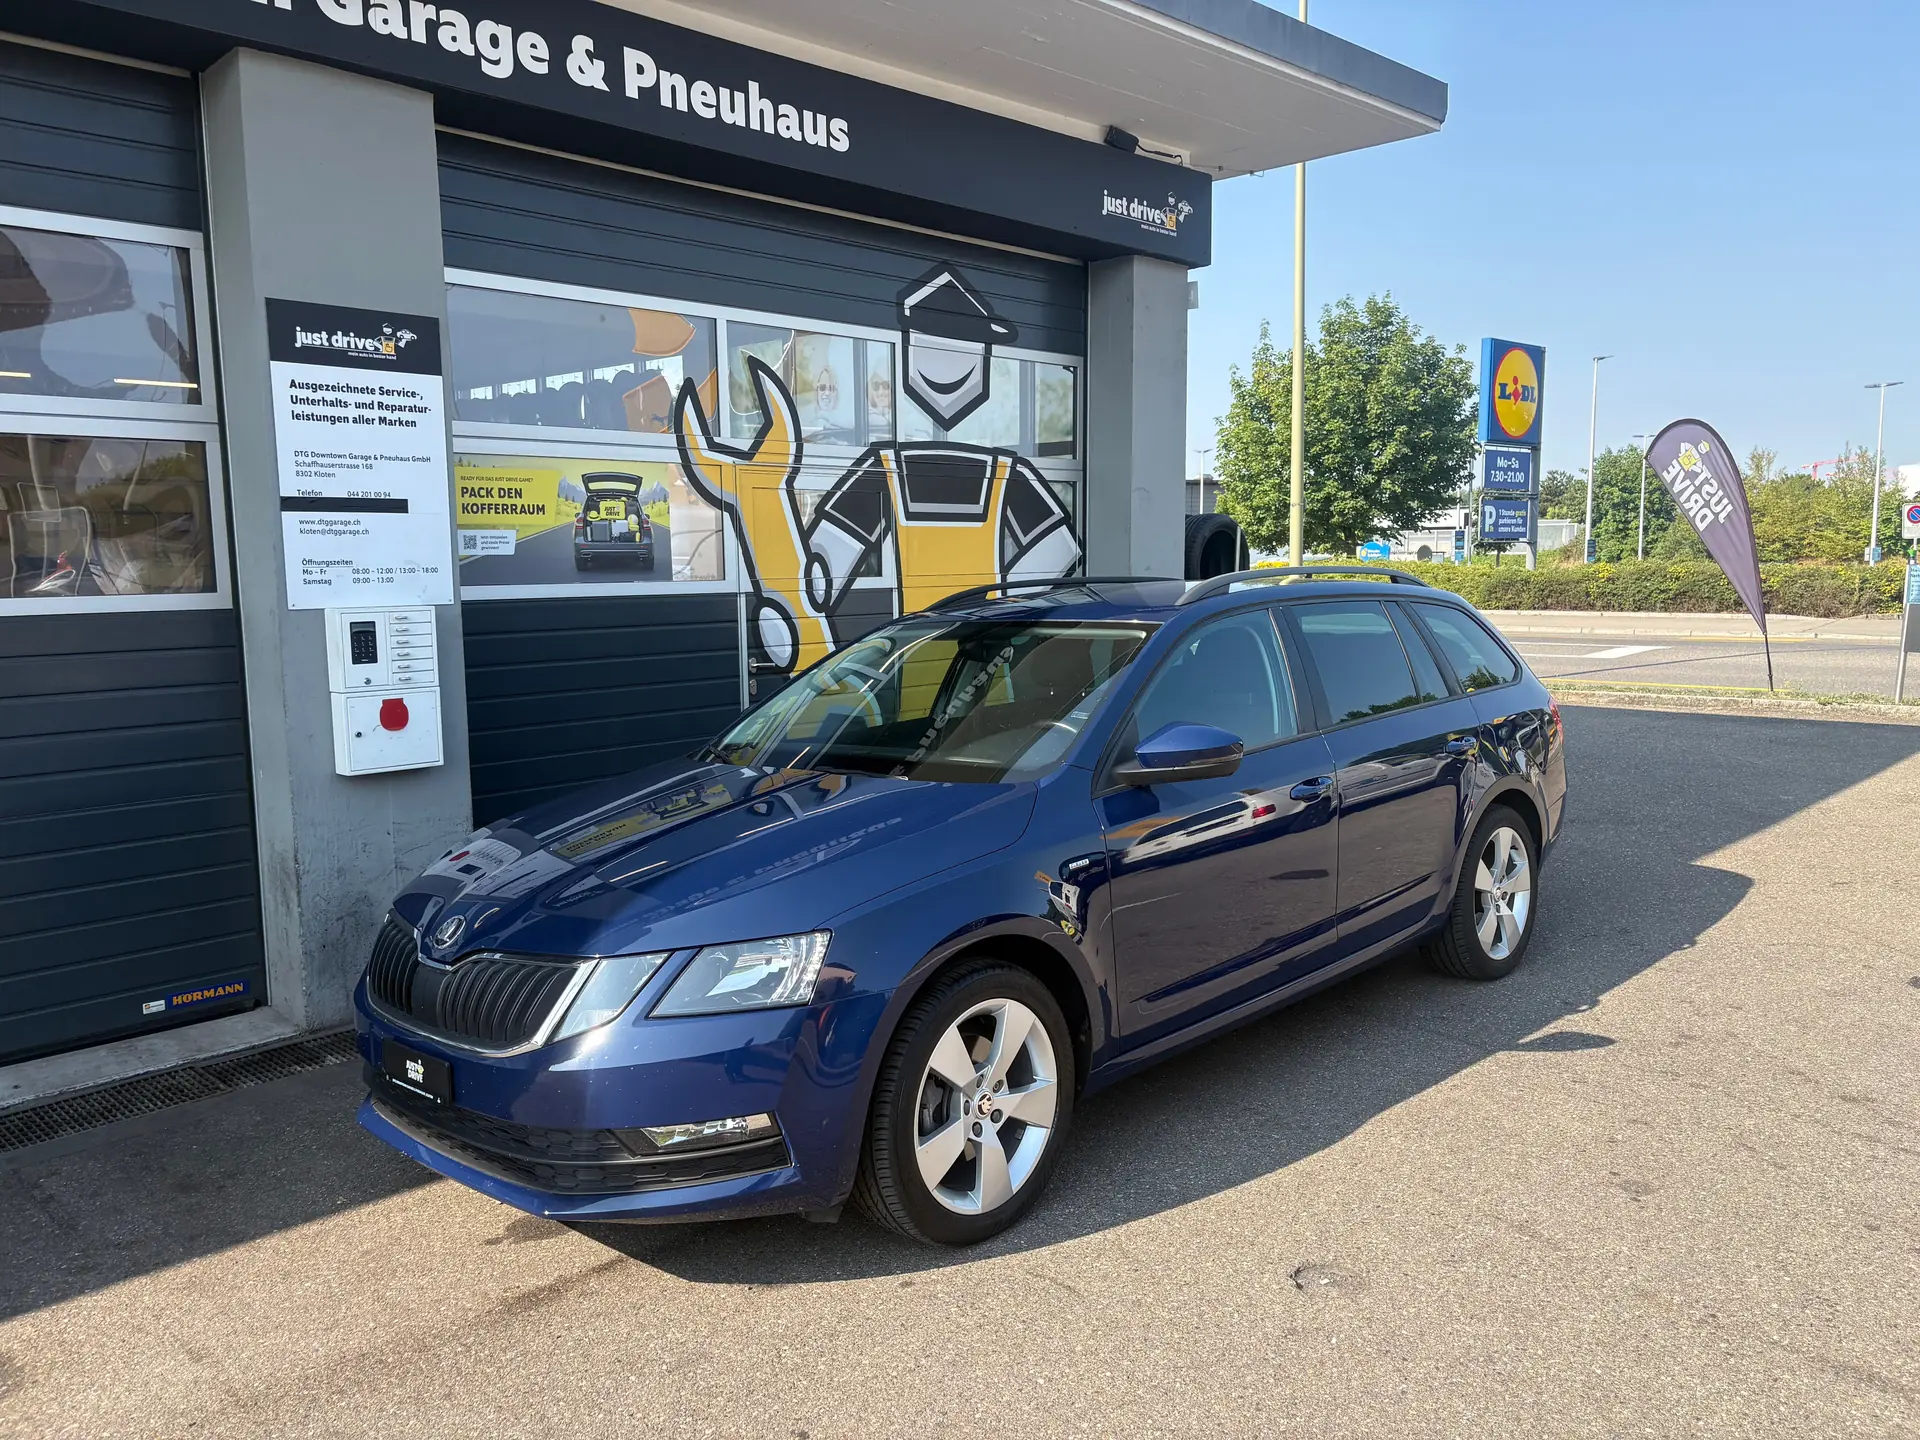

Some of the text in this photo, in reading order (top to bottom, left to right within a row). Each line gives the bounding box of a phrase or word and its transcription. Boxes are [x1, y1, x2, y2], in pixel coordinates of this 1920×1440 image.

[566, 34, 610, 92] &
[622, 45, 851, 154] Pneuhaus
[1102, 189, 1162, 224] just drive
[295, 326, 375, 351] just drive
[289, 378, 423, 400] Ausgezeichnete Service-,
[290, 394, 432, 414] Unterhalts- und Reparatur-
[291, 409, 417, 428] leistungen aller Marken
[294, 450, 309, 458] DTG
[310, 451, 348, 460] Downtown
[348, 453, 372, 461] Garage
[379, 454, 411, 463] Pneuhaus
[294, 460, 360, 470] Schaffhauserstrasse
[295, 470, 313, 478] 8302
[296, 489, 323, 497] Telefon
[347, 490, 360, 498] 044
[460, 486, 523, 499] PACK DEN
[461, 502, 546, 516] KOFFERRAUM
[298, 518, 361, 527] www.dtggarage.ch
[299, 528, 370, 536] kloten@dtggarage.ch
[301, 558, 353, 567] Öffnungszeiten
[302, 578, 332, 586] Samstag
